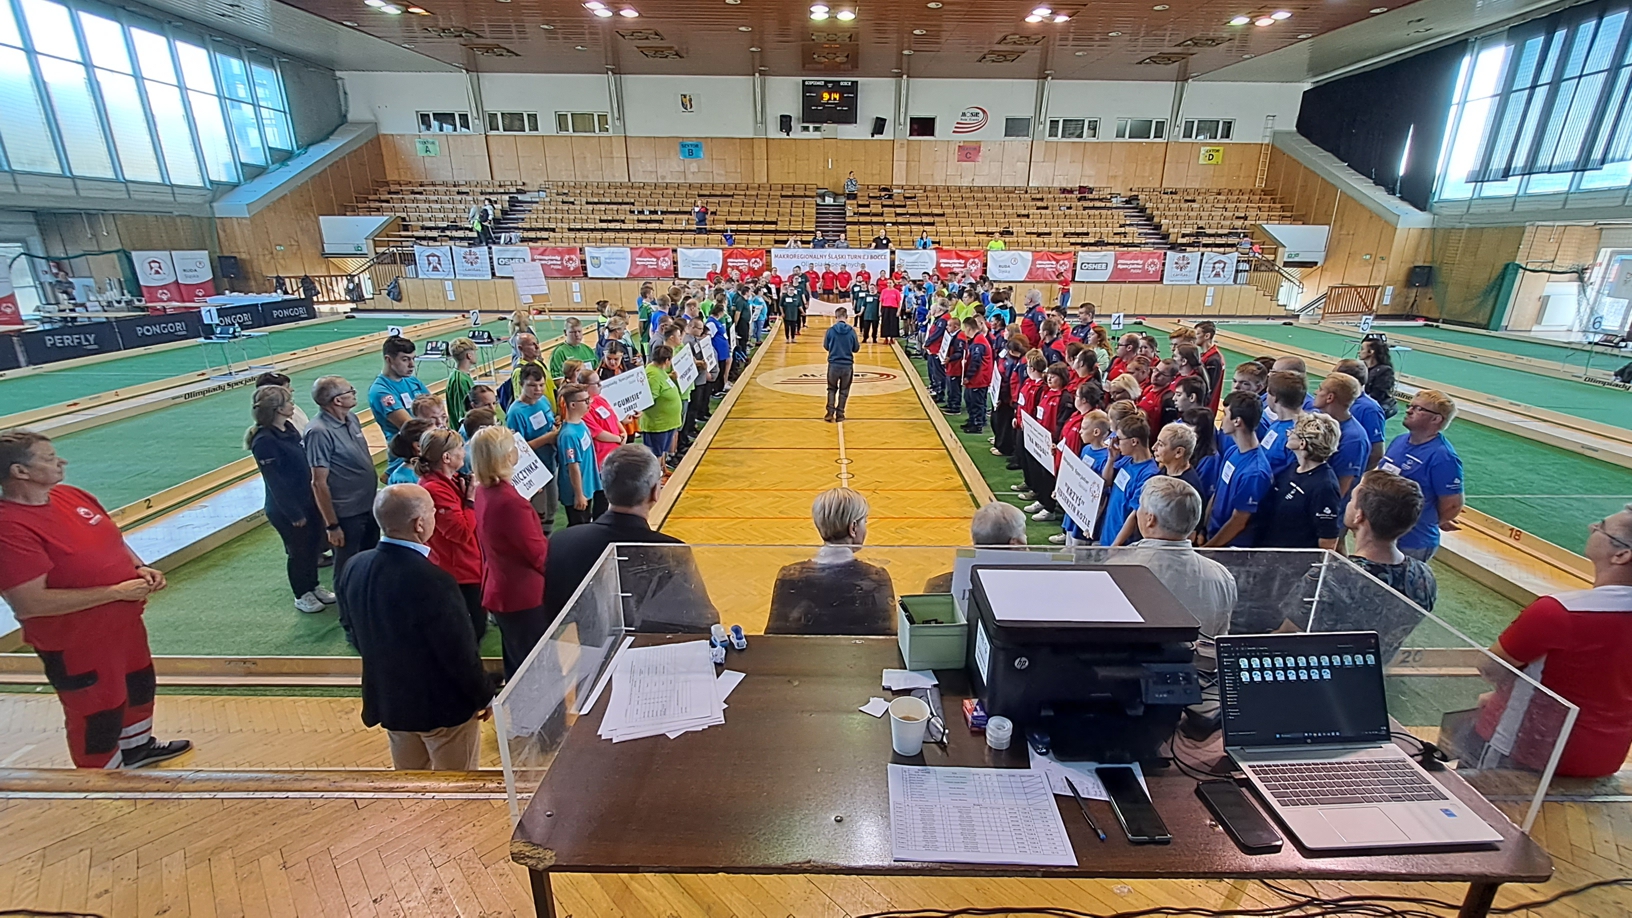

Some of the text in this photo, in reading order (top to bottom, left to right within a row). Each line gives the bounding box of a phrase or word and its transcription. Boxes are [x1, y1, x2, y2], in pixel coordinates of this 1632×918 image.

[425, 145, 431, 153] A
[687, 148, 694, 156] B
[965, 151, 972, 159] C
[1207, 153, 1214, 161] D
[828, 252, 847, 261] ŚLĄSKI
[205, 308, 214, 322] 1
[273, 306, 307, 318] PONGORI
[472, 311, 480, 326] 2
[218, 313, 252, 326] ONGORI
[1112, 314, 1122, 328] 4
[1361, 318, 1371, 332] 5
[1592, 316, 1603, 330] 6
[136, 321, 187, 337] PONGORI
[44, 333, 96, 348] PERFLY
[184, 376, 257, 400] Olimpiady Specjal
[1583, 376, 1632, 391] Olimpiady
[511, 459, 539, 487] NICZYNKA"
[144, 498, 153, 510] 2
[1508, 528, 1523, 541] 18
[1015, 656, 1028, 670] hp
